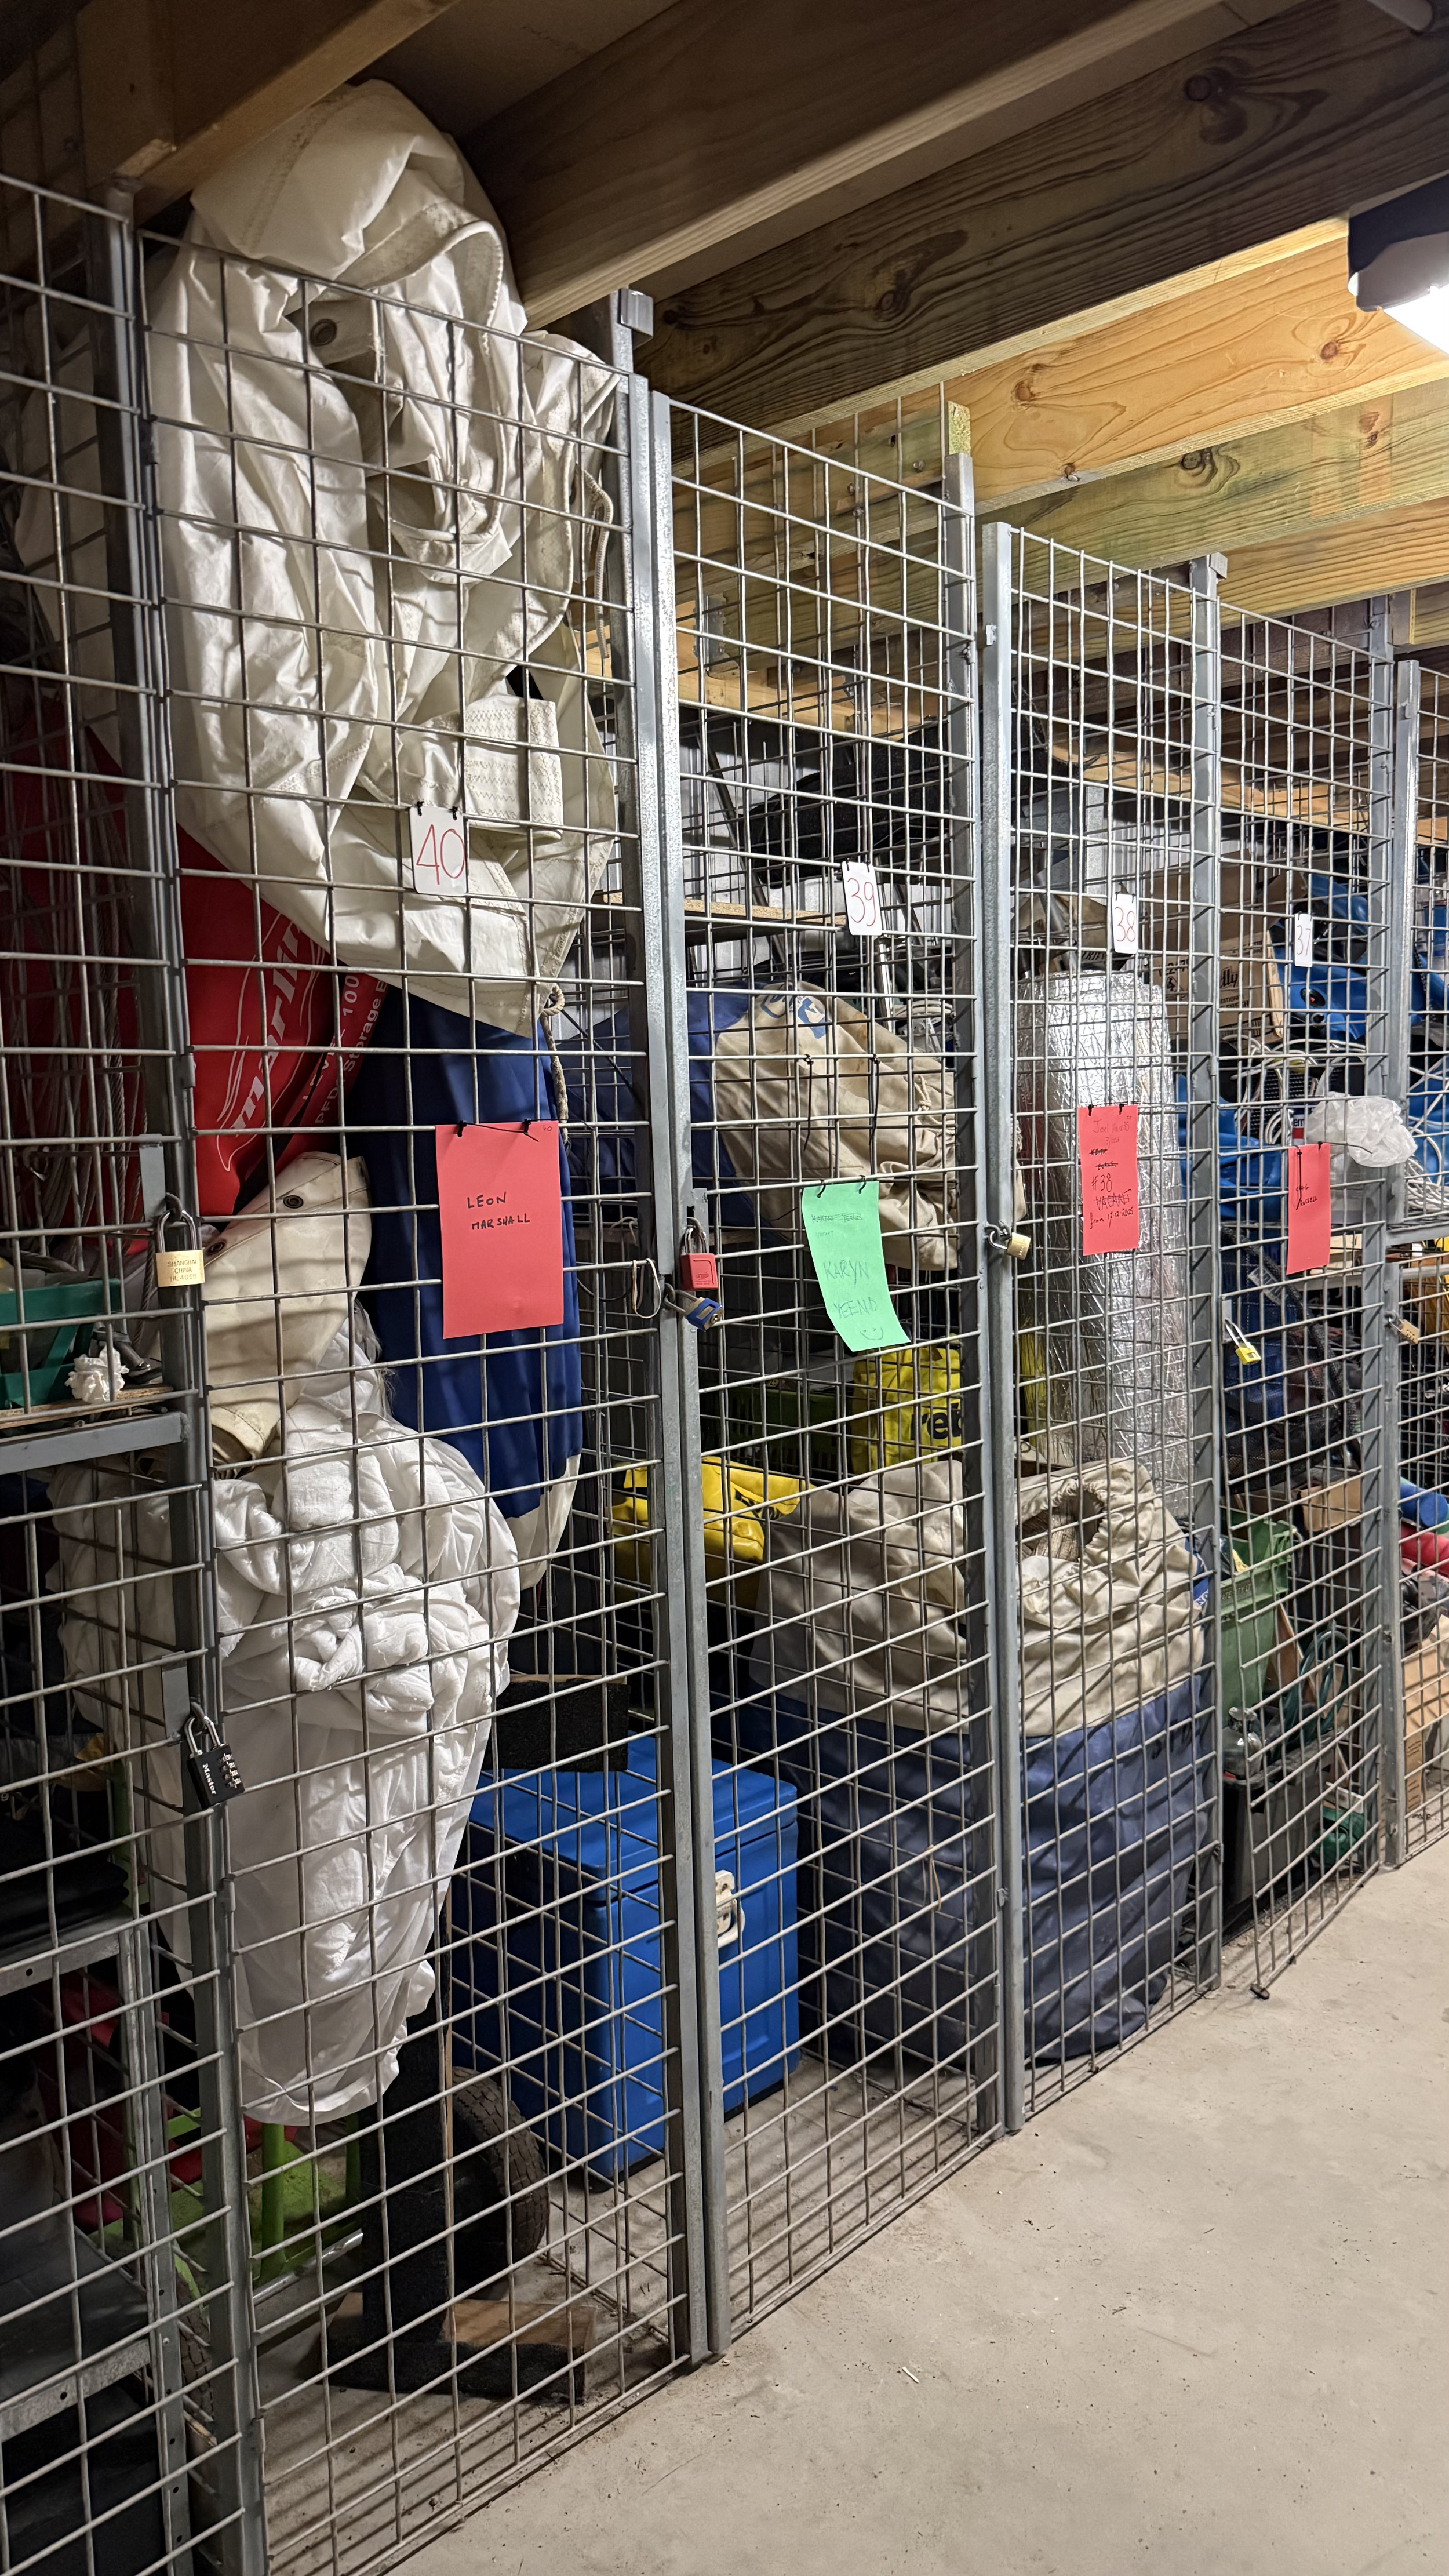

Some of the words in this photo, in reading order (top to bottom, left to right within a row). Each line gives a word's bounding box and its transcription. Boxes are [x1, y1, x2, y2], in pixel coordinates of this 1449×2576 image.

[416, 824, 465, 885] 40
[847, 878, 876, 927] 39
[1115, 906, 1136, 943] 38
[1297, 925, 1311, 956] 37
[343, 975, 359, 1016] 100
[1091, 1173, 1112, 1192] #38
[467, 1191, 507, 1209] LEON
[471, 1213, 530, 1230] MARSHALL
[202, 1763, 217, 1795] Master
